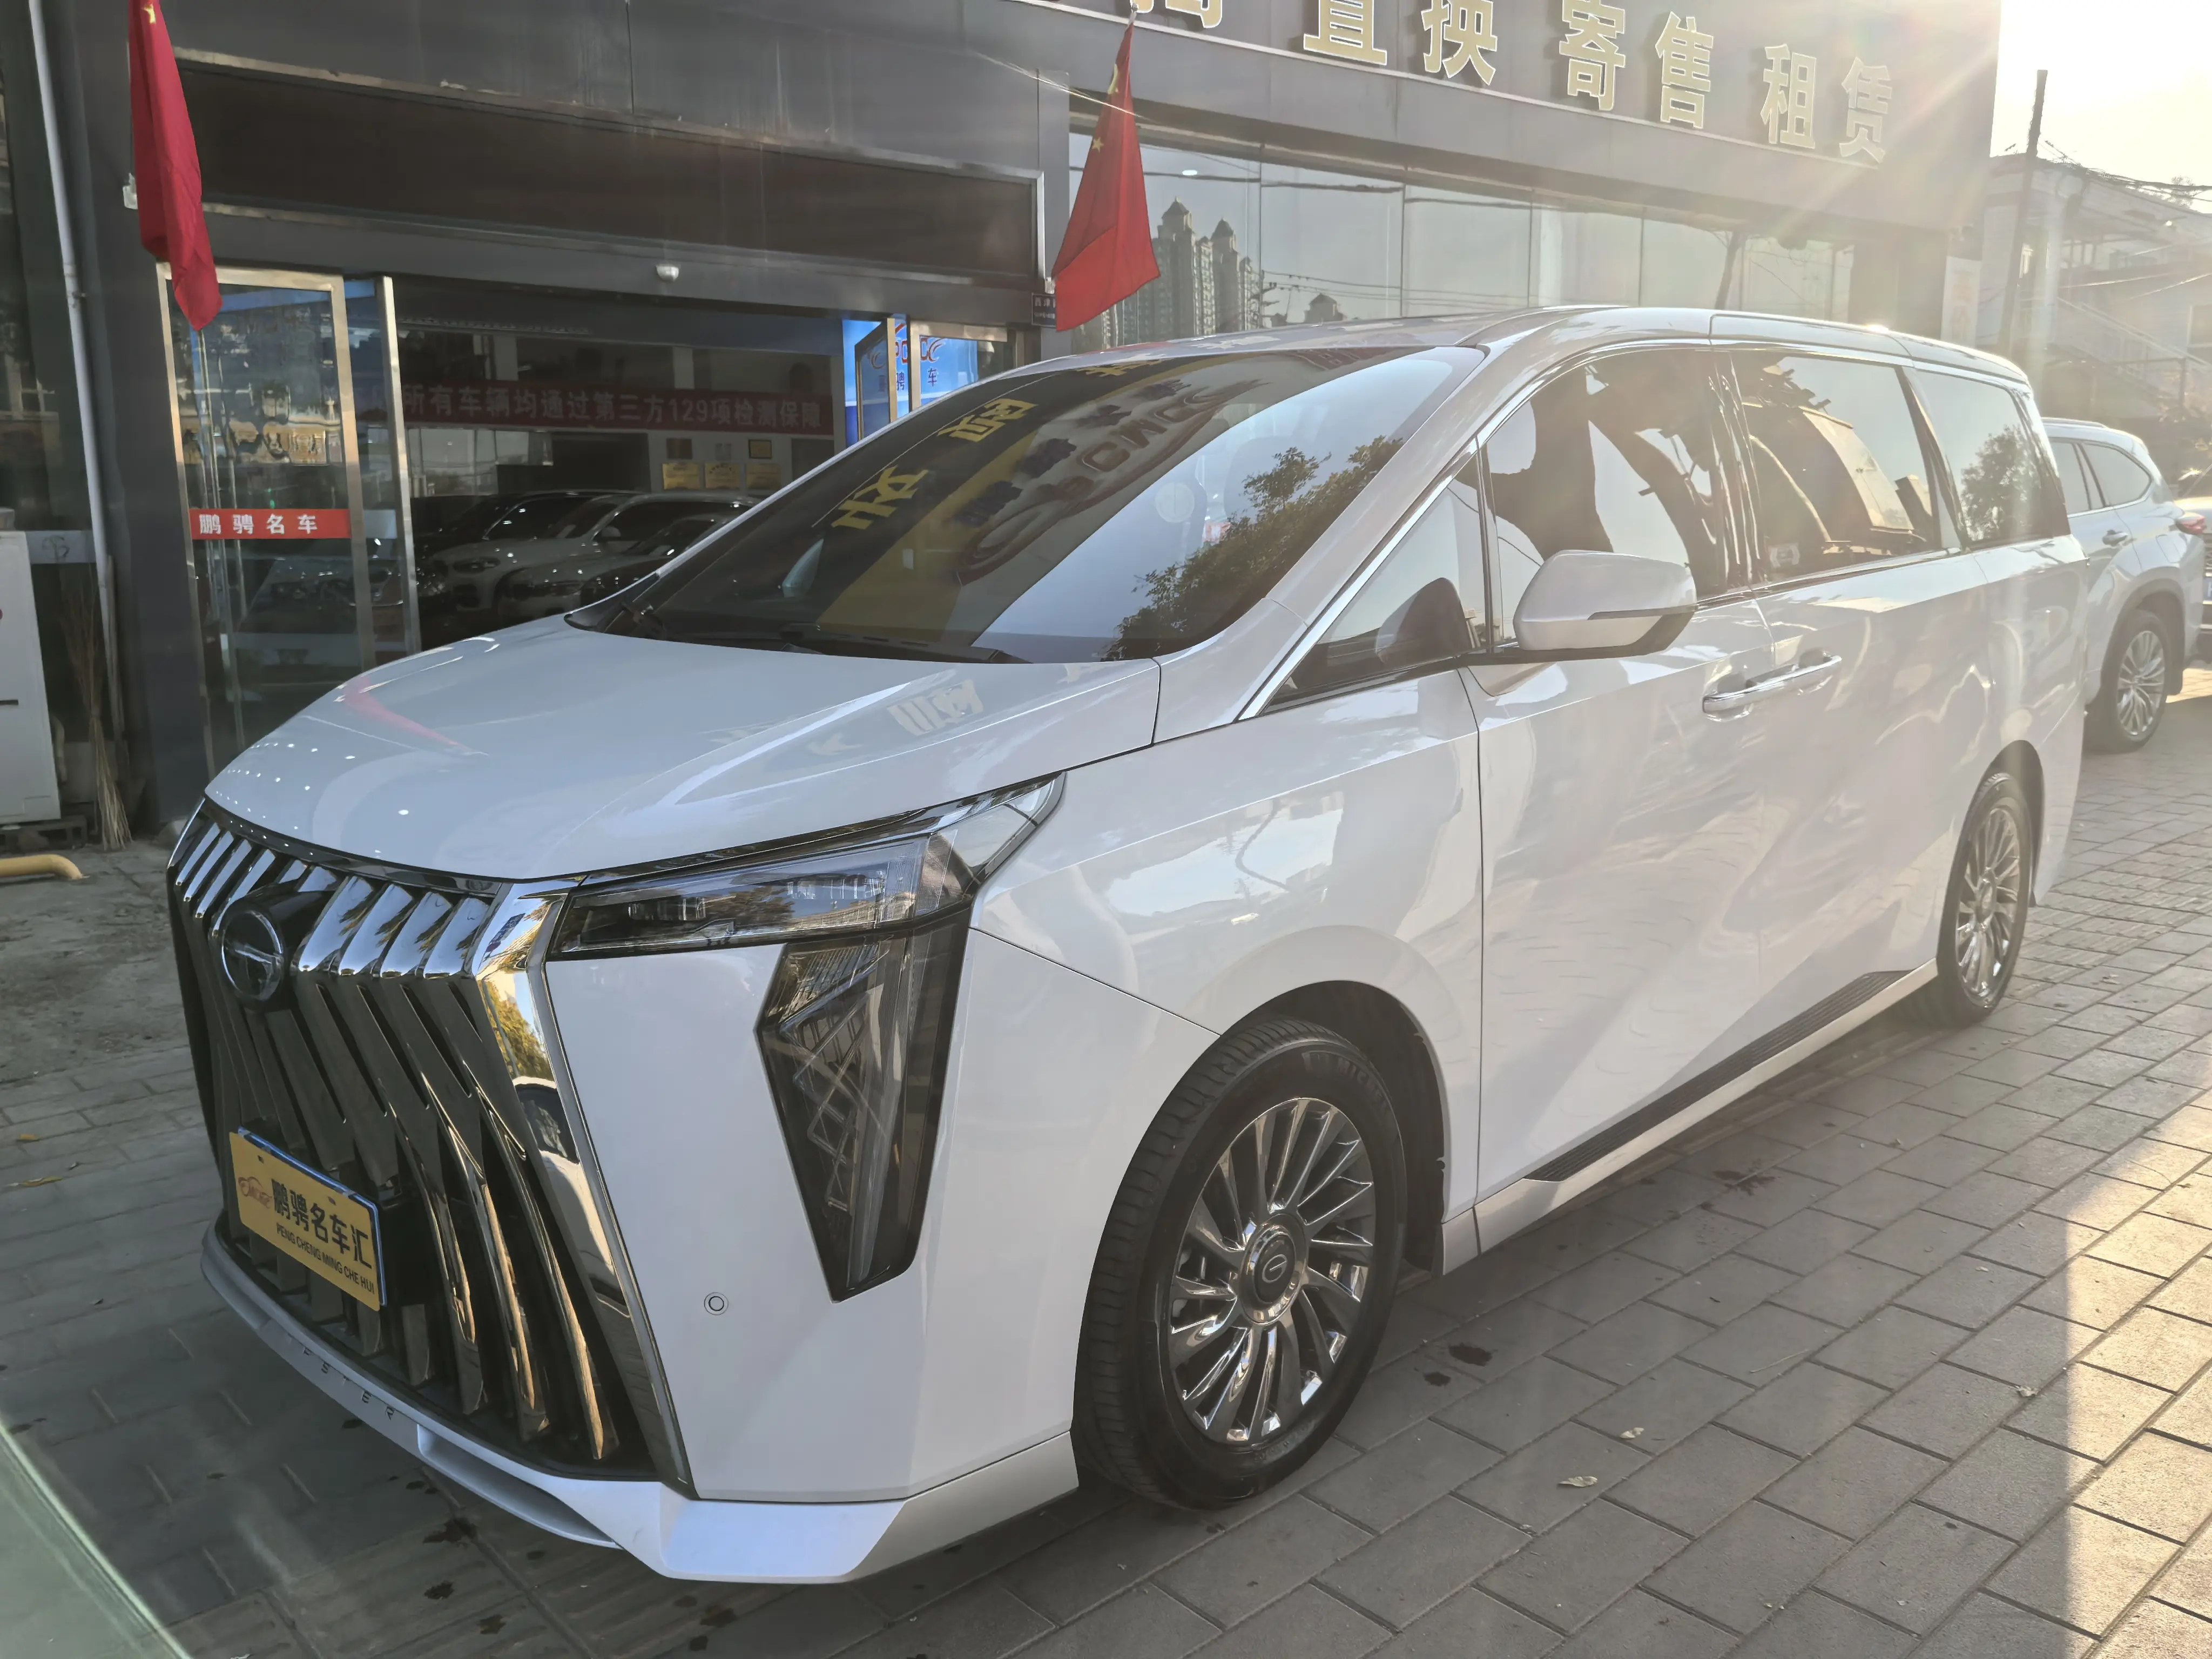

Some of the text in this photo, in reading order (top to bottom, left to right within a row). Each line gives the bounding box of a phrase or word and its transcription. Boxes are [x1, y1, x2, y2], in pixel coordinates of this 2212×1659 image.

[1559, 0, 1715, 129] 寄售
[1760, 43, 1893, 164] 租赁
[199, 513, 318, 535] 鹏骋名车
[272, 1178, 372, 1269] 鹏骋名车汇
[276, 1222, 375, 1294] PENG CHENG MING CHE HUI
